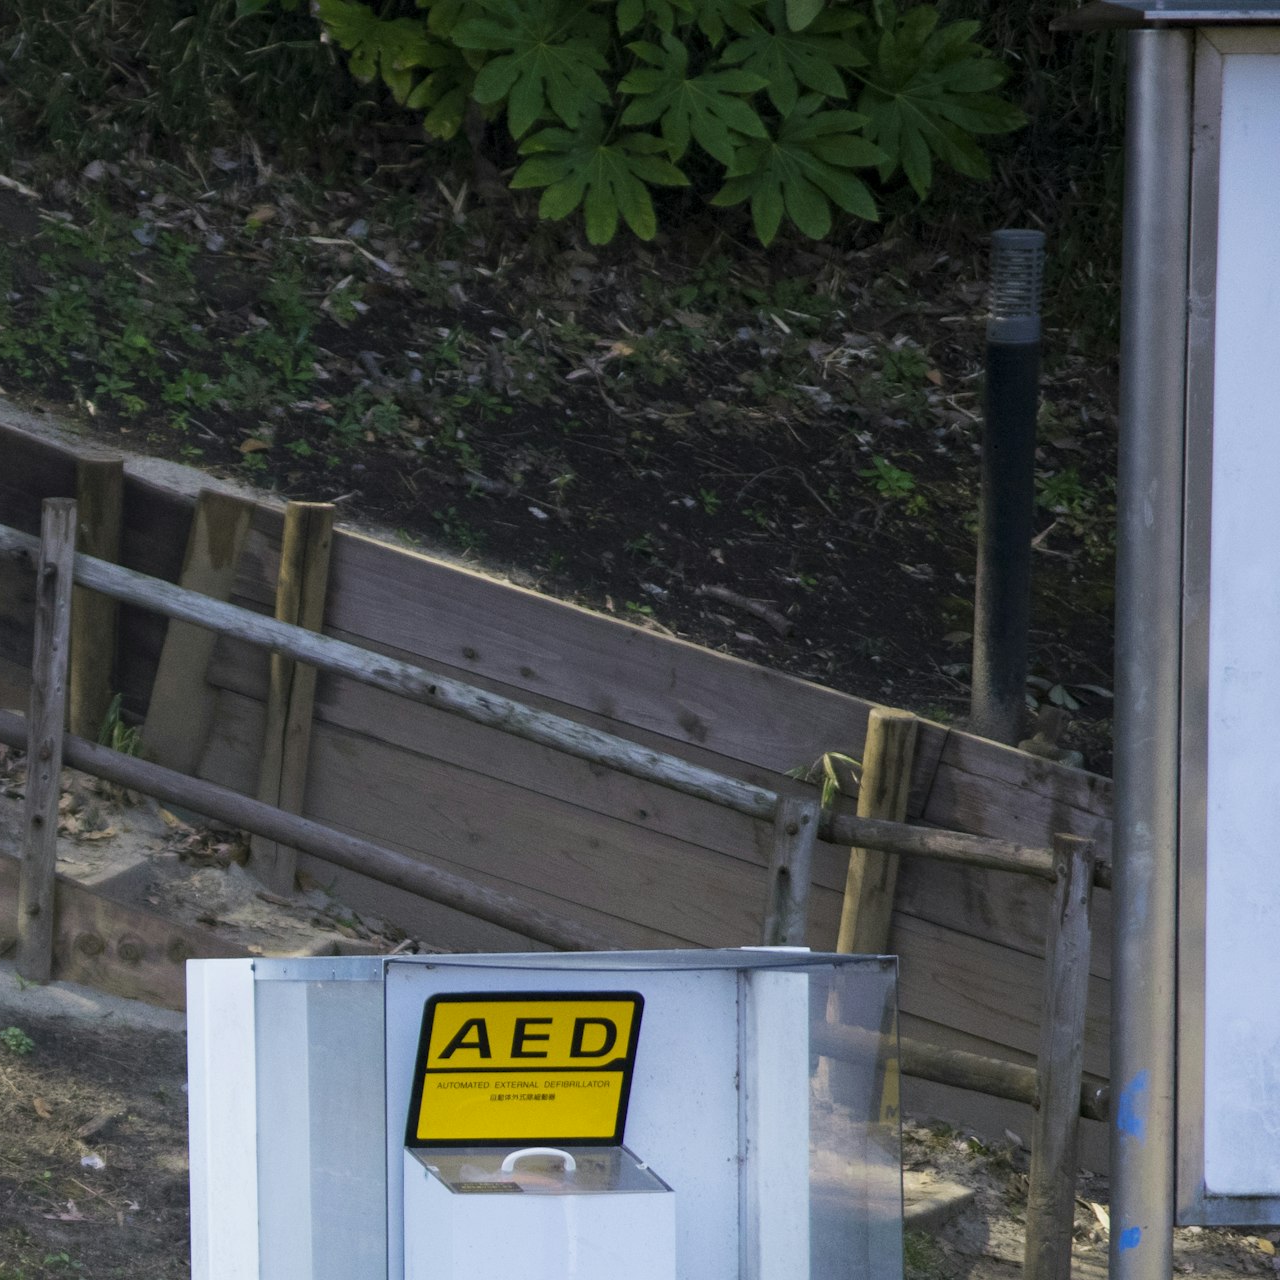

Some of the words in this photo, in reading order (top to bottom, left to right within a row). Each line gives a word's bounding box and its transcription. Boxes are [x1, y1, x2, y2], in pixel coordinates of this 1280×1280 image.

[438, 1018, 617, 1059] AED
[437, 1081, 489, 1089] AUTOMATED
[494, 1080, 539, 1089] EXTERNAL
[544, 1080, 610, 1089] DEFIBRILLATOR
